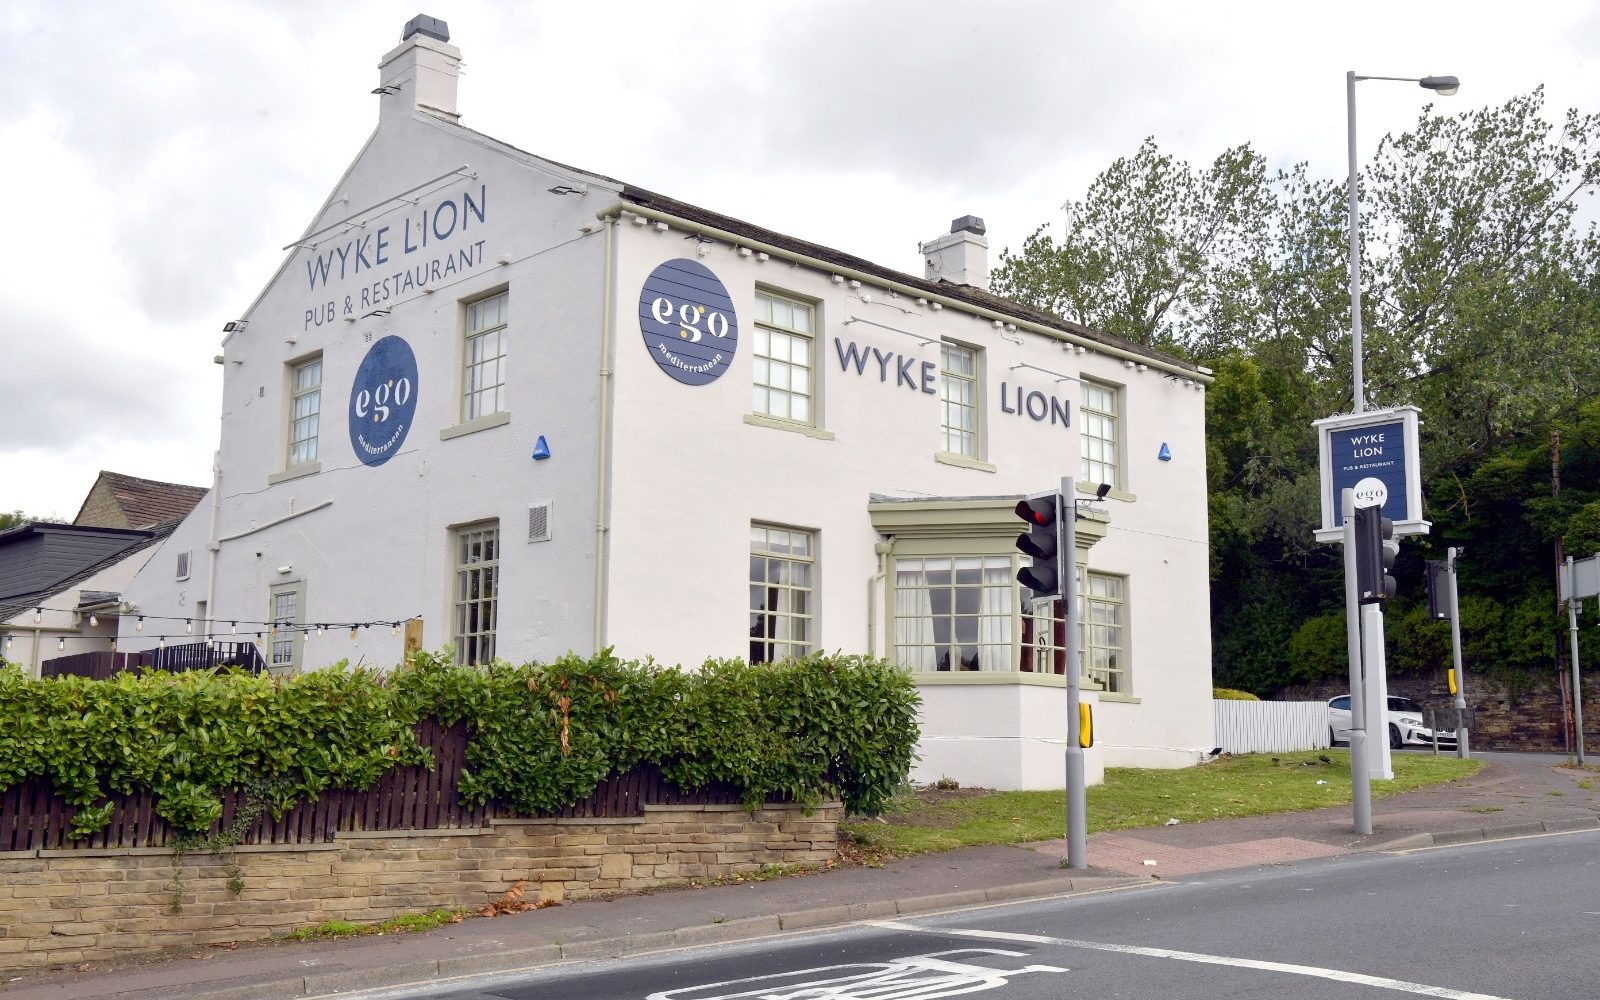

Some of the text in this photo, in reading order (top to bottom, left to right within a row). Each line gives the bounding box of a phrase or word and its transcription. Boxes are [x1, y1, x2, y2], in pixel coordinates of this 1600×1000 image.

[307, 184, 486, 292] WYKE LION
[304, 240, 486, 332] PUB & RESTAURANT
[651, 297, 729, 343] ego
[658, 342, 723, 373] mediterranean
[834, 337, 1070, 428] WYKE LION
[355, 377, 411, 424] ego
[357, 424, 404, 456] mediterranean
[1350, 433, 1385, 445] WYKE
[1354, 447, 1382, 458] LION
[1360, 461, 1394, 469] RESTAURANT
[1356, 489, 1383, 501] ego
